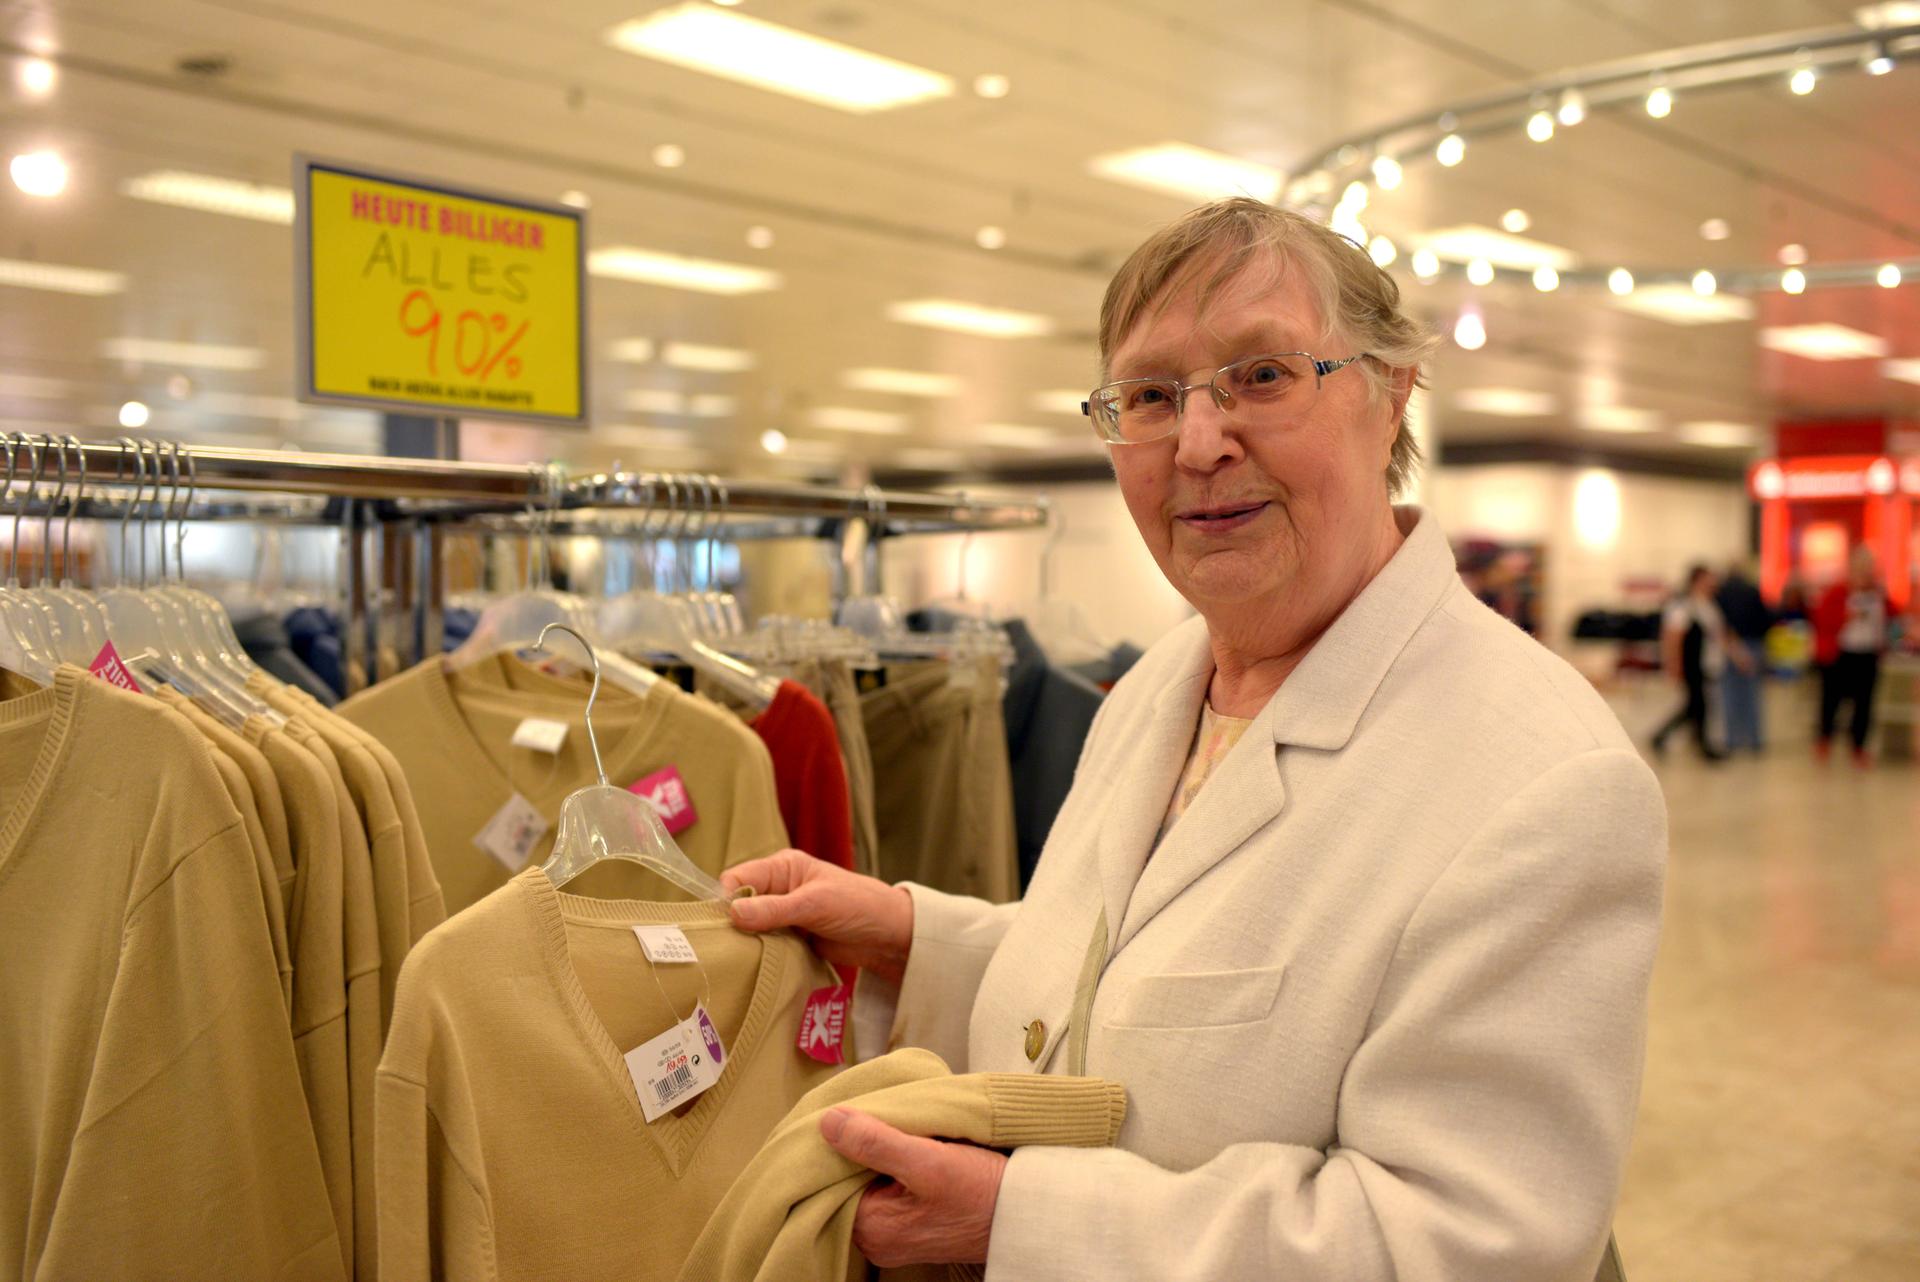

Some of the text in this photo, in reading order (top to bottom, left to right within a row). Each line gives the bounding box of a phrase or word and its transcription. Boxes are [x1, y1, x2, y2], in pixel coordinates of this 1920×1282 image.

[352, 191, 545, 250] HEUTE BILLIGER
[361, 231, 532, 304] ALLES
[399, 289, 531, 382] 90%
[829, 1001, 844, 1046] TEILE
